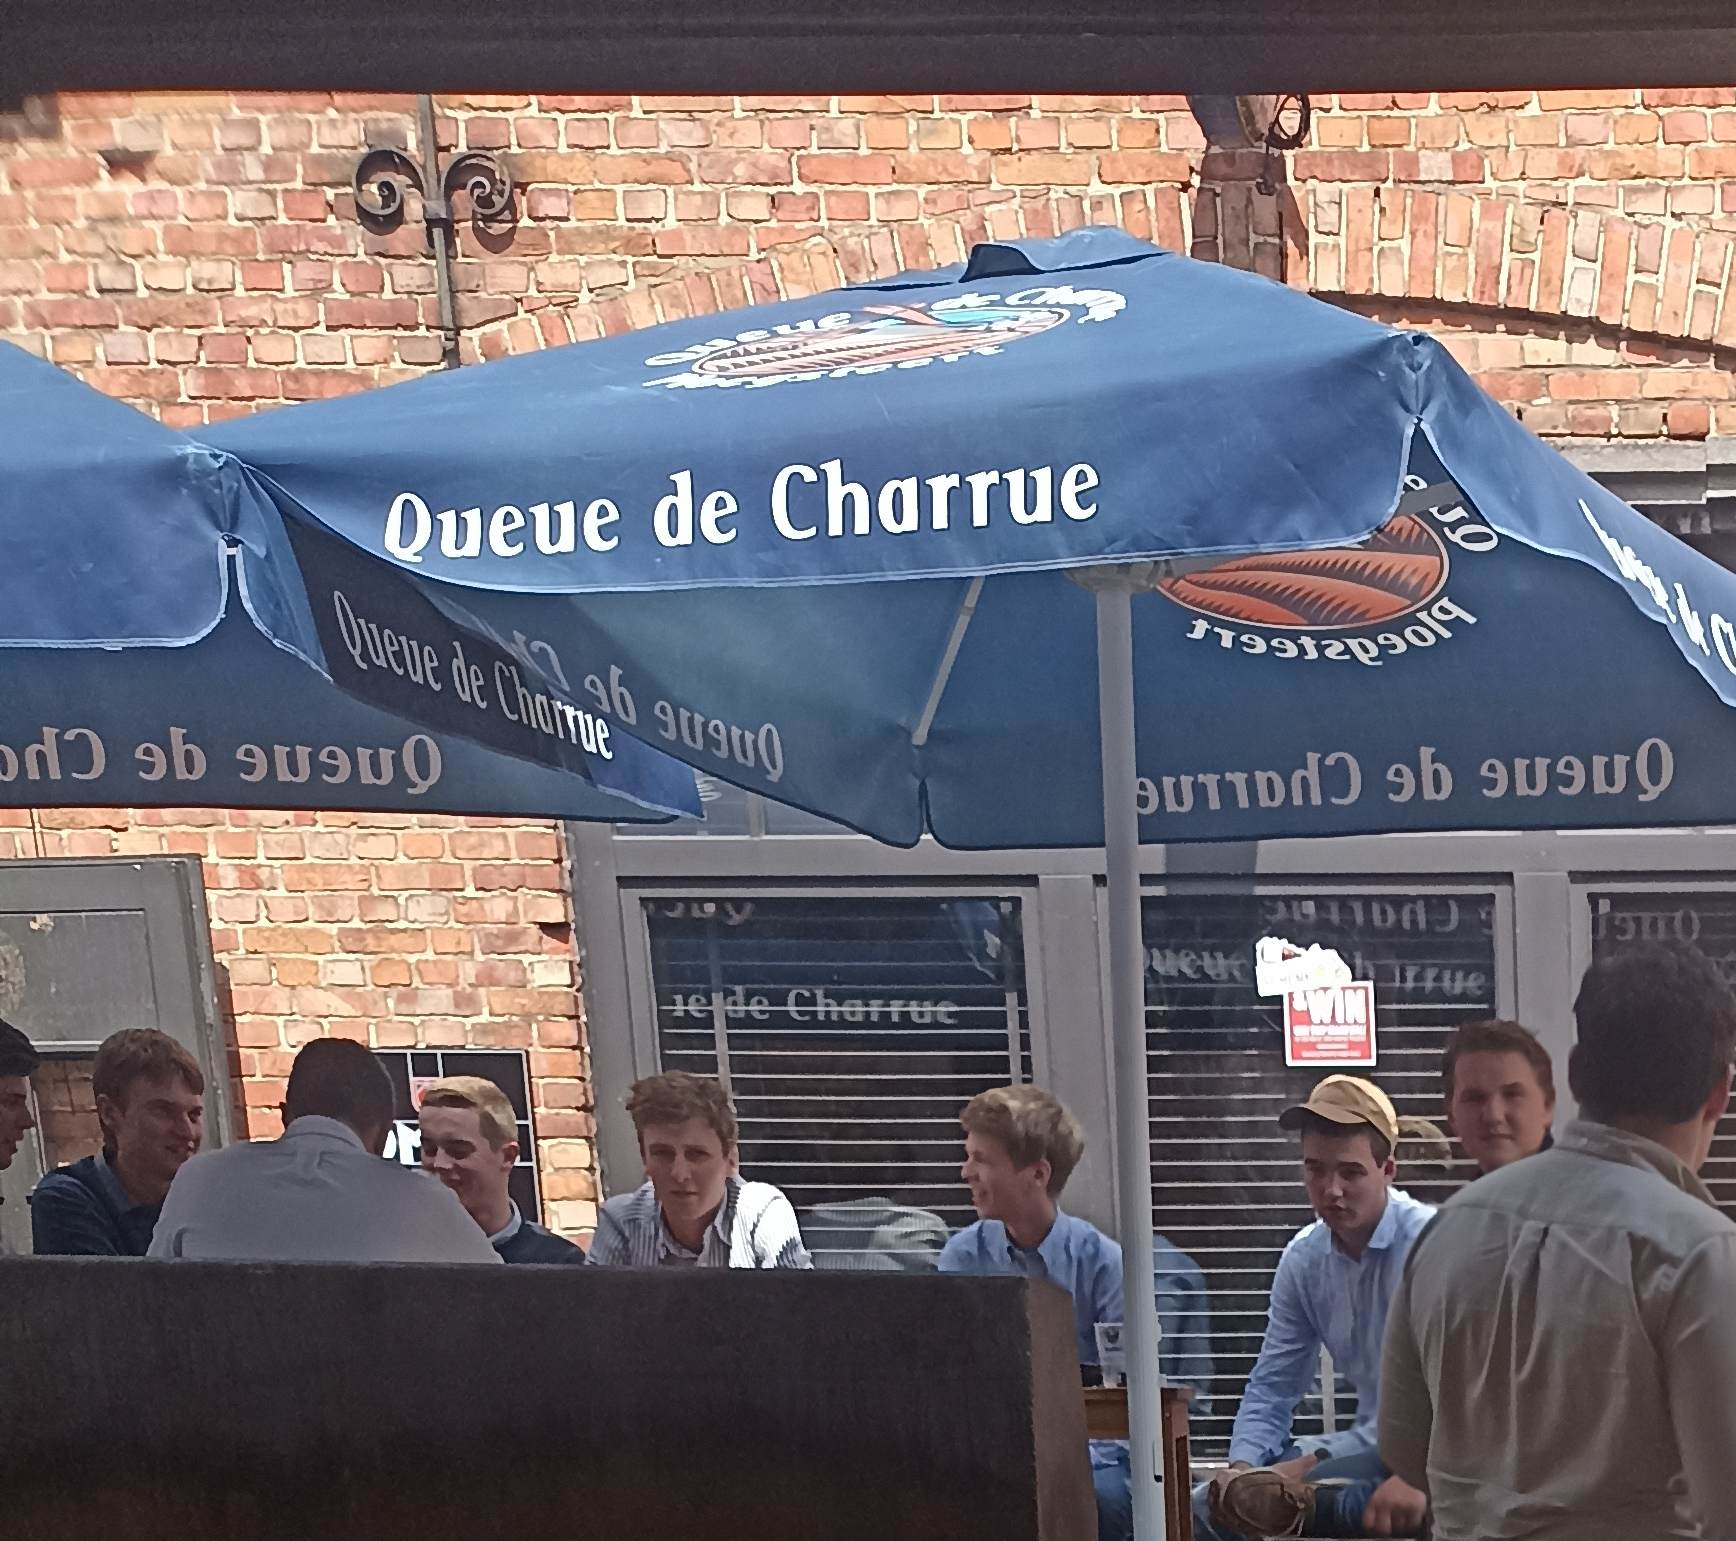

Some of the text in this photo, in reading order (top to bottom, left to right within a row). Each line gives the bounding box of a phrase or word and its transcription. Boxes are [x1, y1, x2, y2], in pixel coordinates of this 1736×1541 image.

[384, 458, 1099, 564] Queue de Charrue
[333, 590, 442, 692] Queue
[451, 640, 488, 709] de
[494, 660, 613, 761] Charrue
